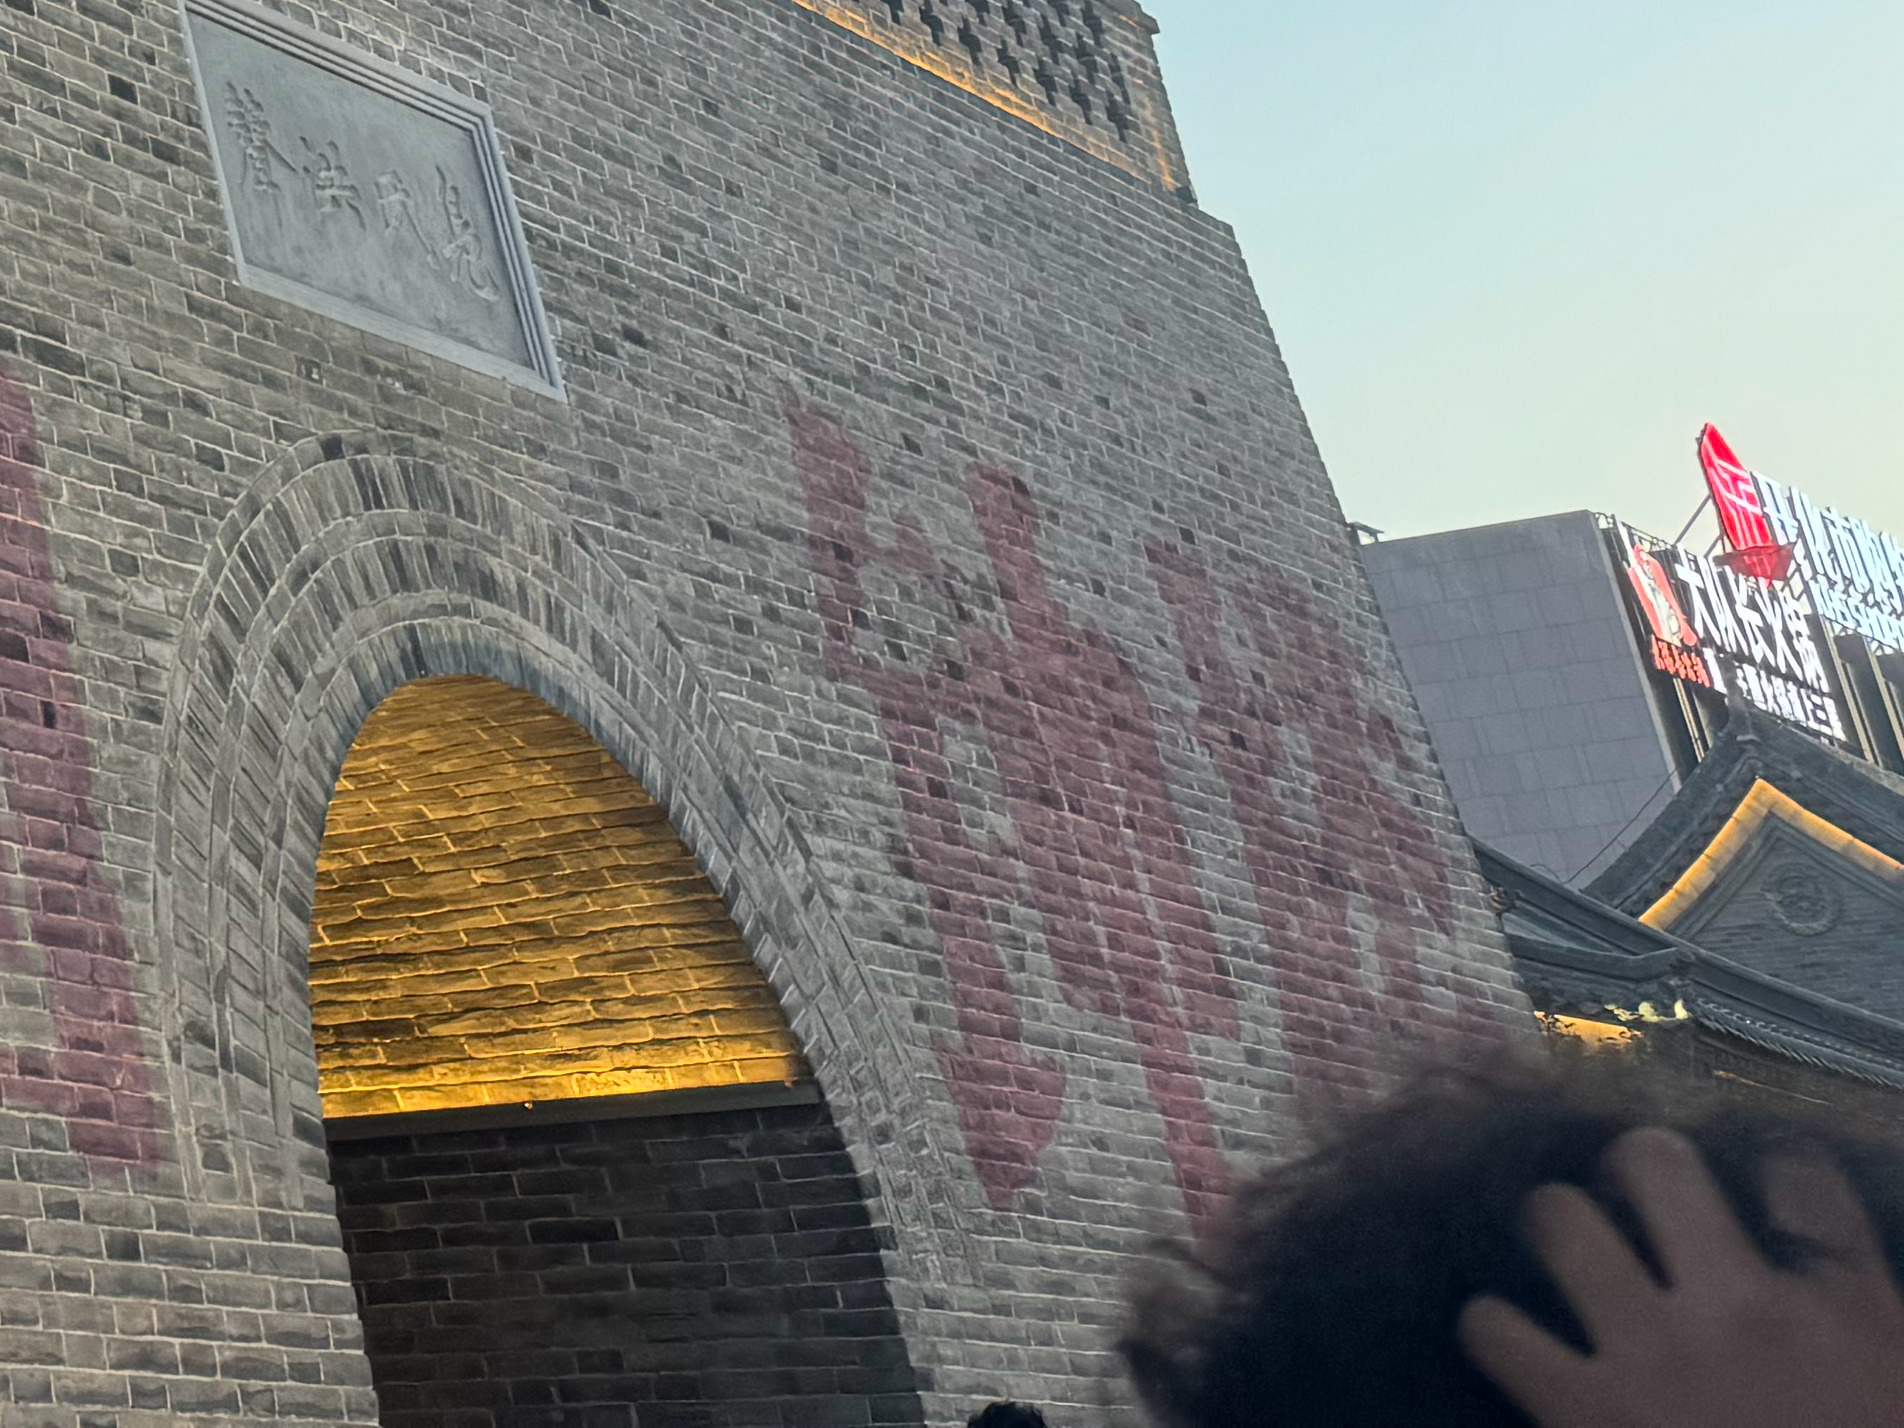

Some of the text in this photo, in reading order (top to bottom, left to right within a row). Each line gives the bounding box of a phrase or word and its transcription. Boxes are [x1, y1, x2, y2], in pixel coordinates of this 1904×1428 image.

[1675, 542, 1831, 694] 大队长火锅
